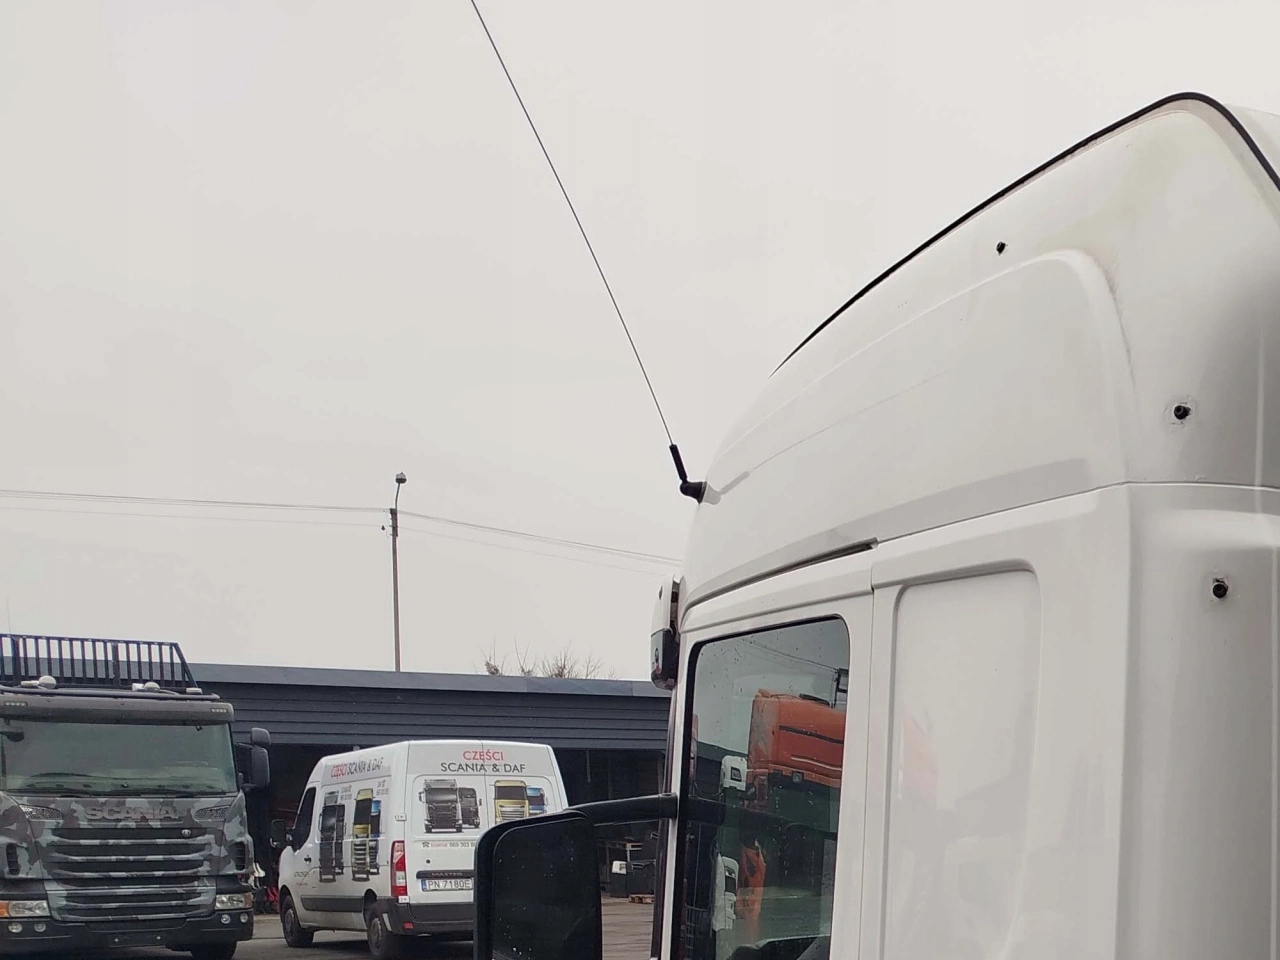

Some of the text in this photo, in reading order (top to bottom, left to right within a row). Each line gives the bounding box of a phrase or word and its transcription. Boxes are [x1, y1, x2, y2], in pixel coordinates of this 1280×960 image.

[463, 749, 504, 762] CZĘŚCI
[347, 760, 366, 776] SCANIA
[372, 757, 384, 771] DAF
[440, 762, 526, 773] SCANIA & DAF
[86, 806, 178, 820] SCANIA
[427, 879, 471, 889] PN 7180E
